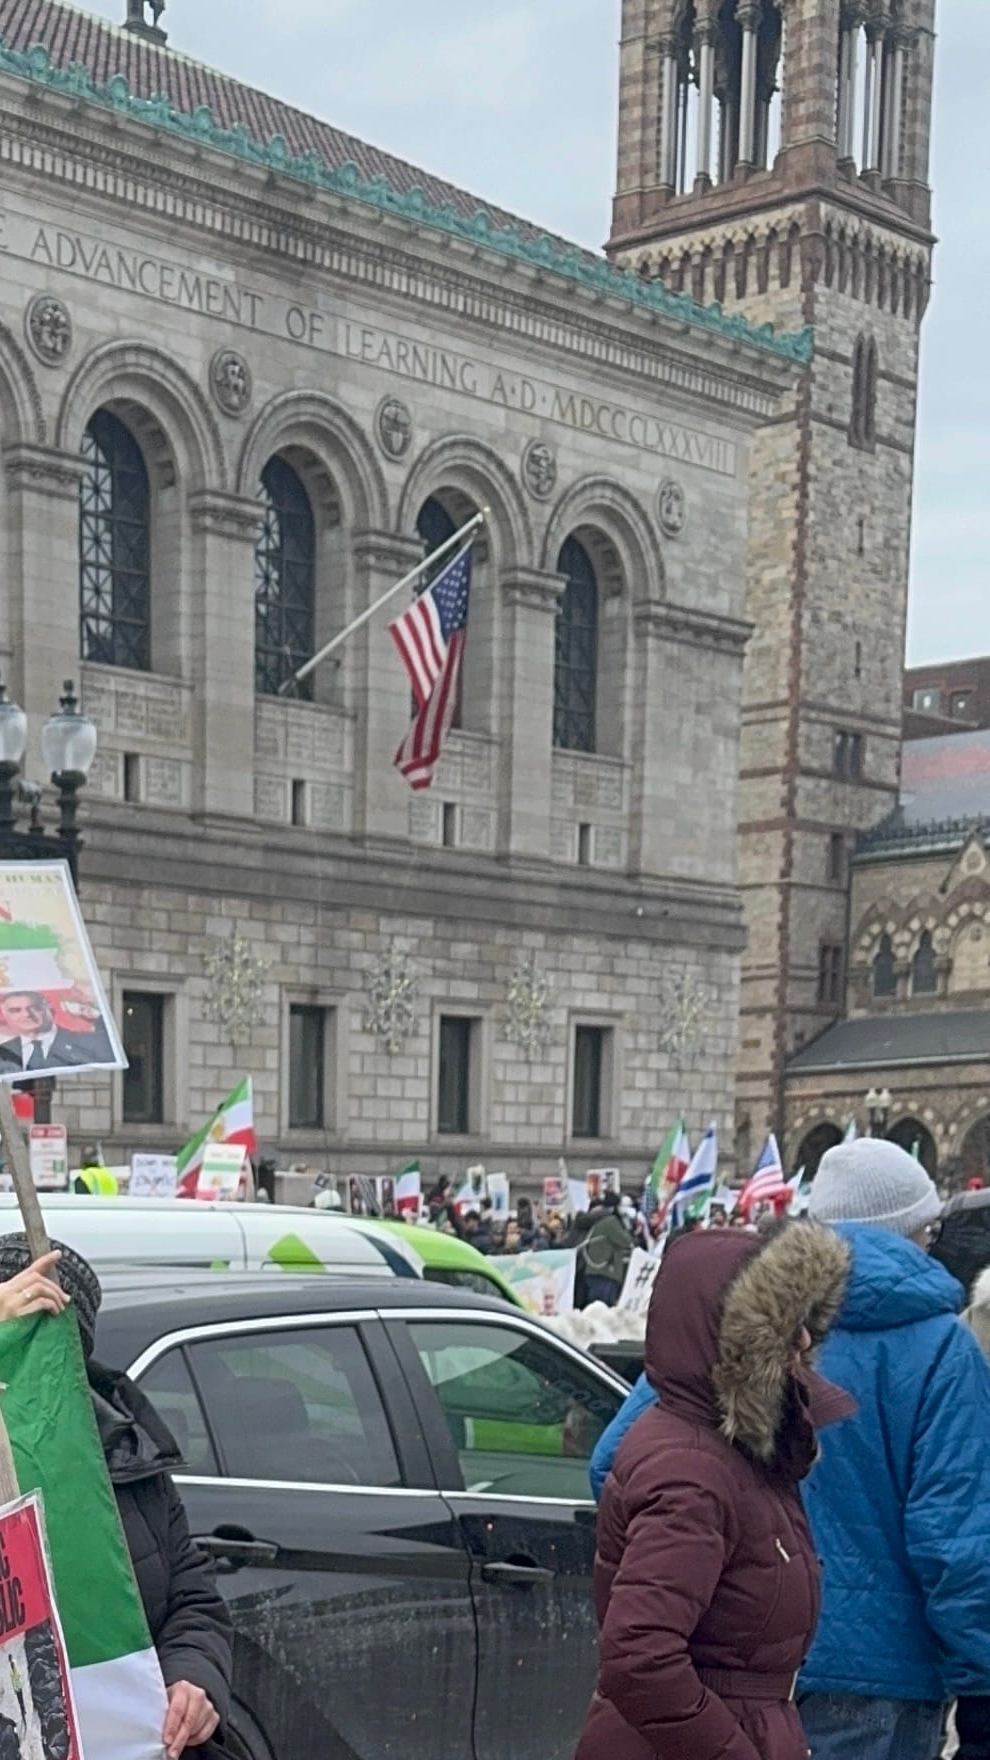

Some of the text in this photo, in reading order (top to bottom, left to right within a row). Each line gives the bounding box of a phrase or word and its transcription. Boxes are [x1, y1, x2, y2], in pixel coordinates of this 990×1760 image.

[30, 227, 262, 326] ADVANCEMENT
[286, 306, 323, 345] OF
[344, 323, 478, 395] LEARNING
